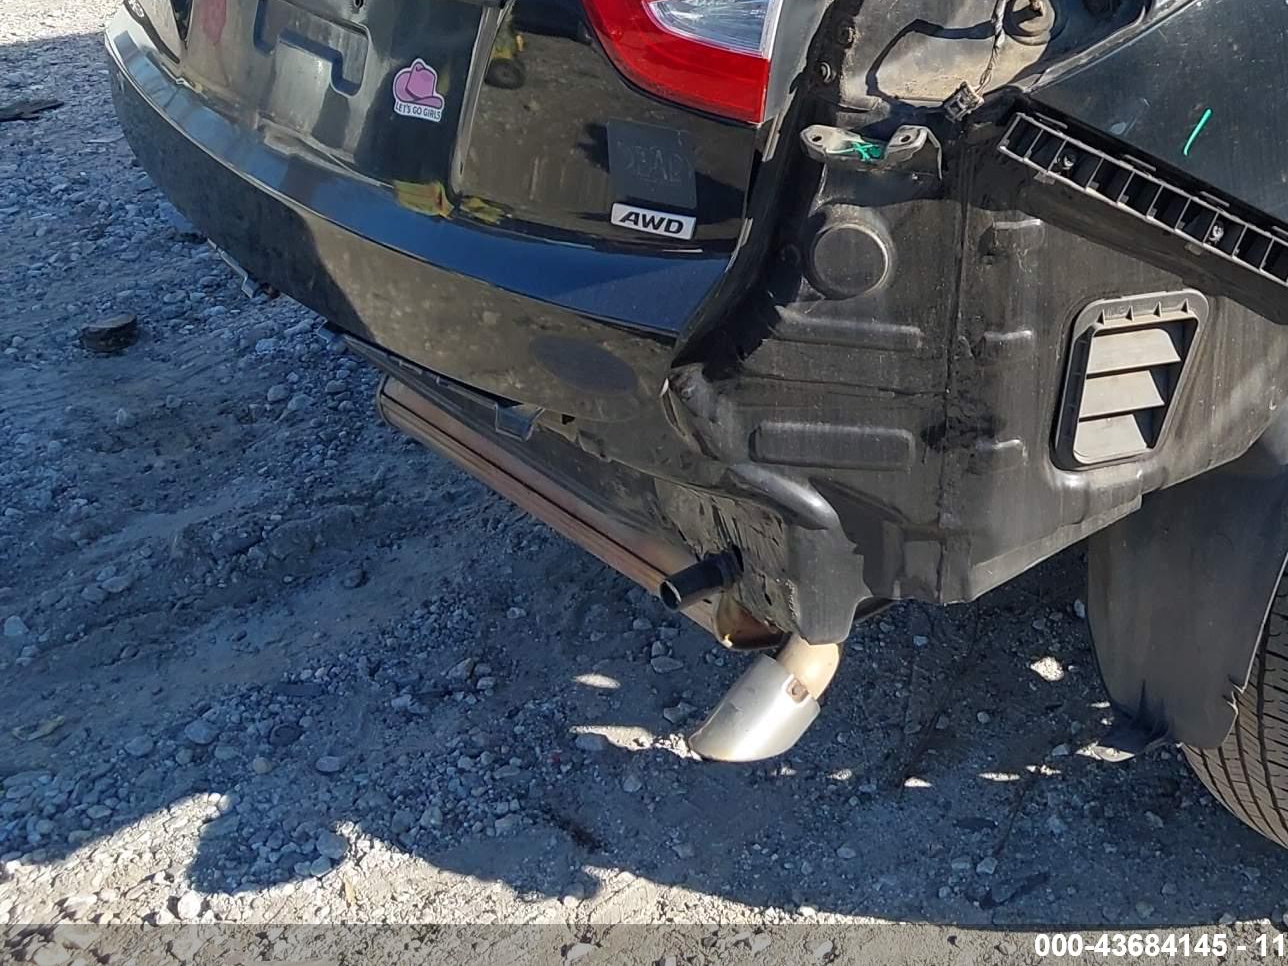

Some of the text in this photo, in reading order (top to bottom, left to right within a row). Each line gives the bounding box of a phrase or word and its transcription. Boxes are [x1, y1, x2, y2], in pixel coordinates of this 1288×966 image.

[396, 101, 441, 120] LET'S GO GIRLS
[619, 211, 684, 235] AWD
